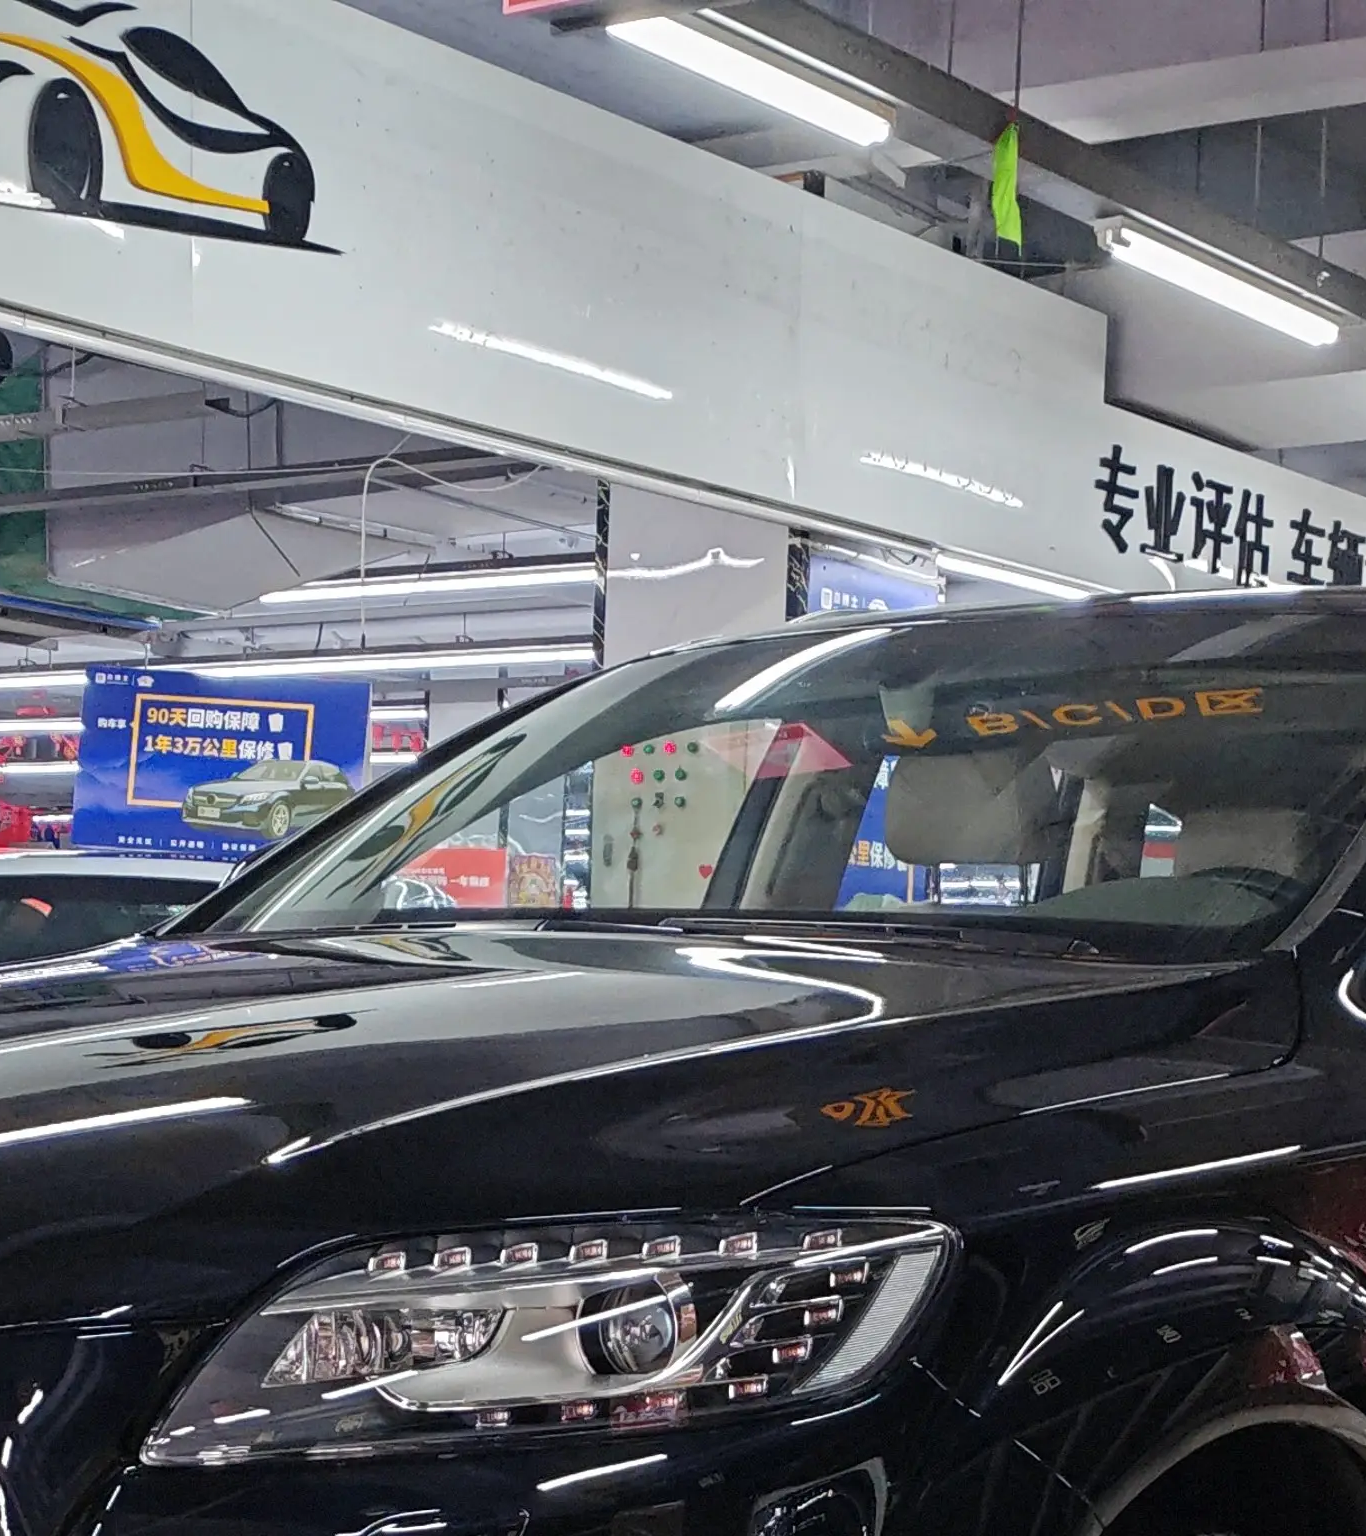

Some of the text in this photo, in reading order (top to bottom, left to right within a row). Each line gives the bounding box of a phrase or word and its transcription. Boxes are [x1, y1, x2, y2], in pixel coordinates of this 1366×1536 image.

[1095, 444, 1274, 587] 专业评估
[147, 707, 260, 732] 90天回购保障
[143, 735, 275, 760] 1年3万公里保修
